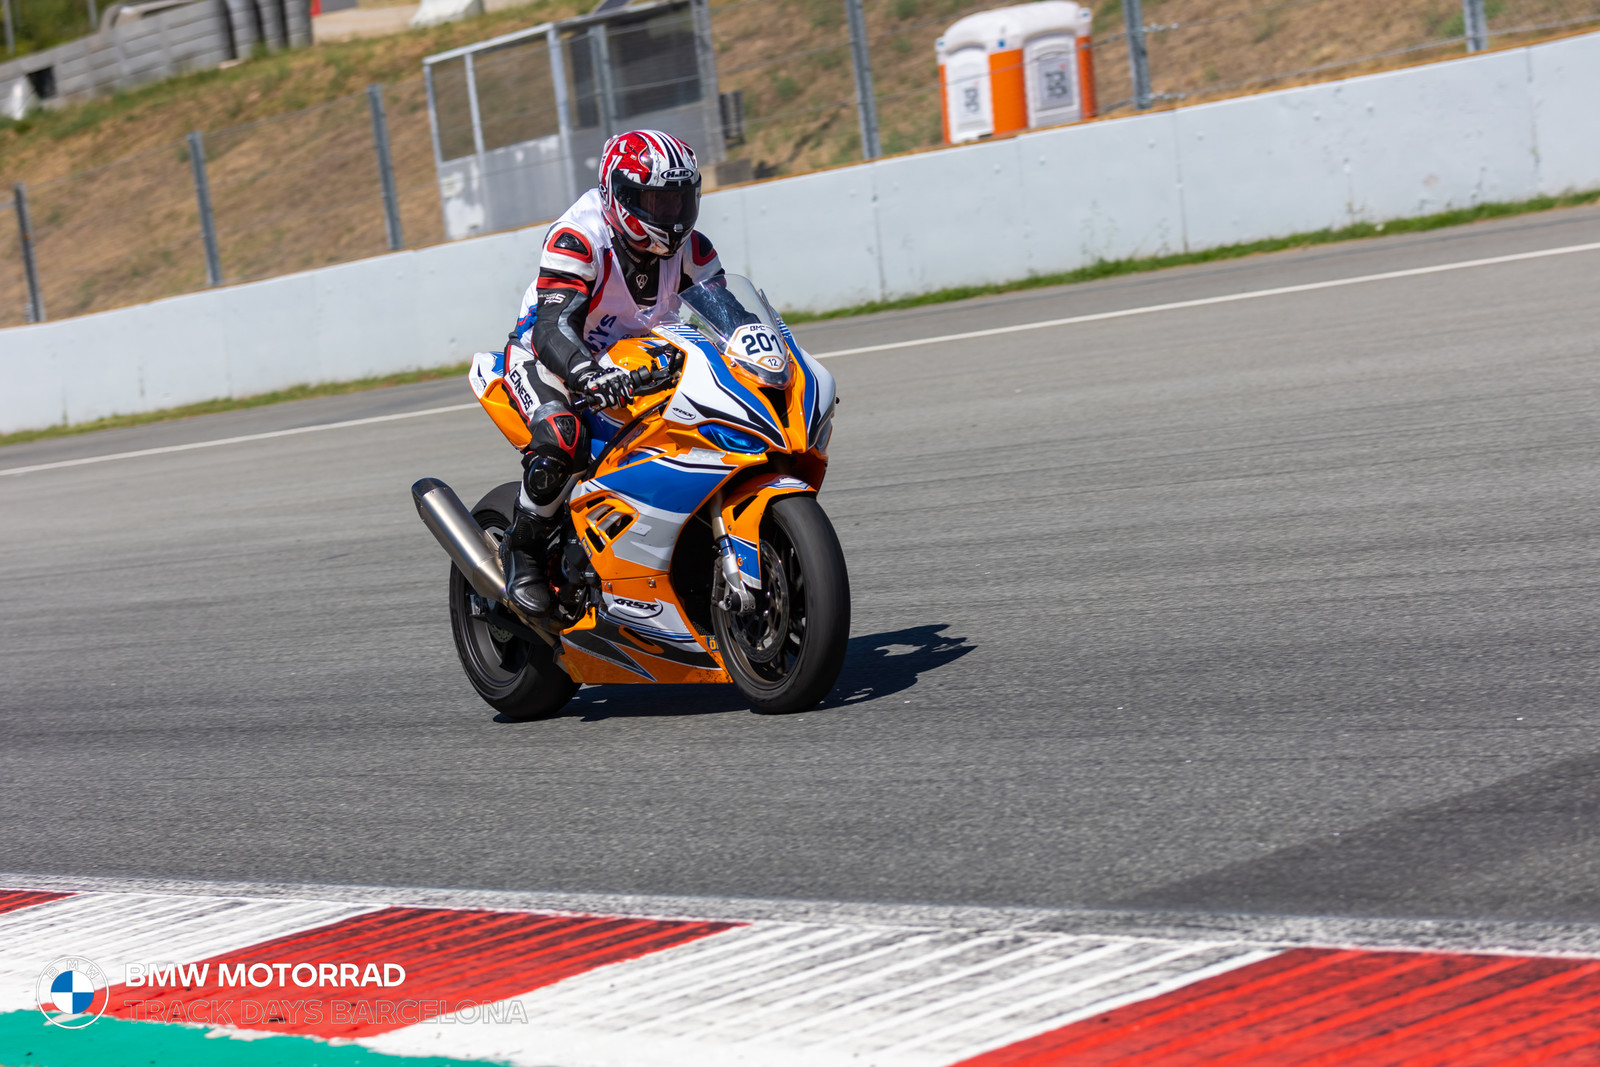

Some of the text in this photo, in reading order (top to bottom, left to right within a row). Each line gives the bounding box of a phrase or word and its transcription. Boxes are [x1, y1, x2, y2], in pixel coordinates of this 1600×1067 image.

[666, 170, 689, 178] HJC
[741, 332, 783, 356] 201
[768, 358, 778, 367] 12
